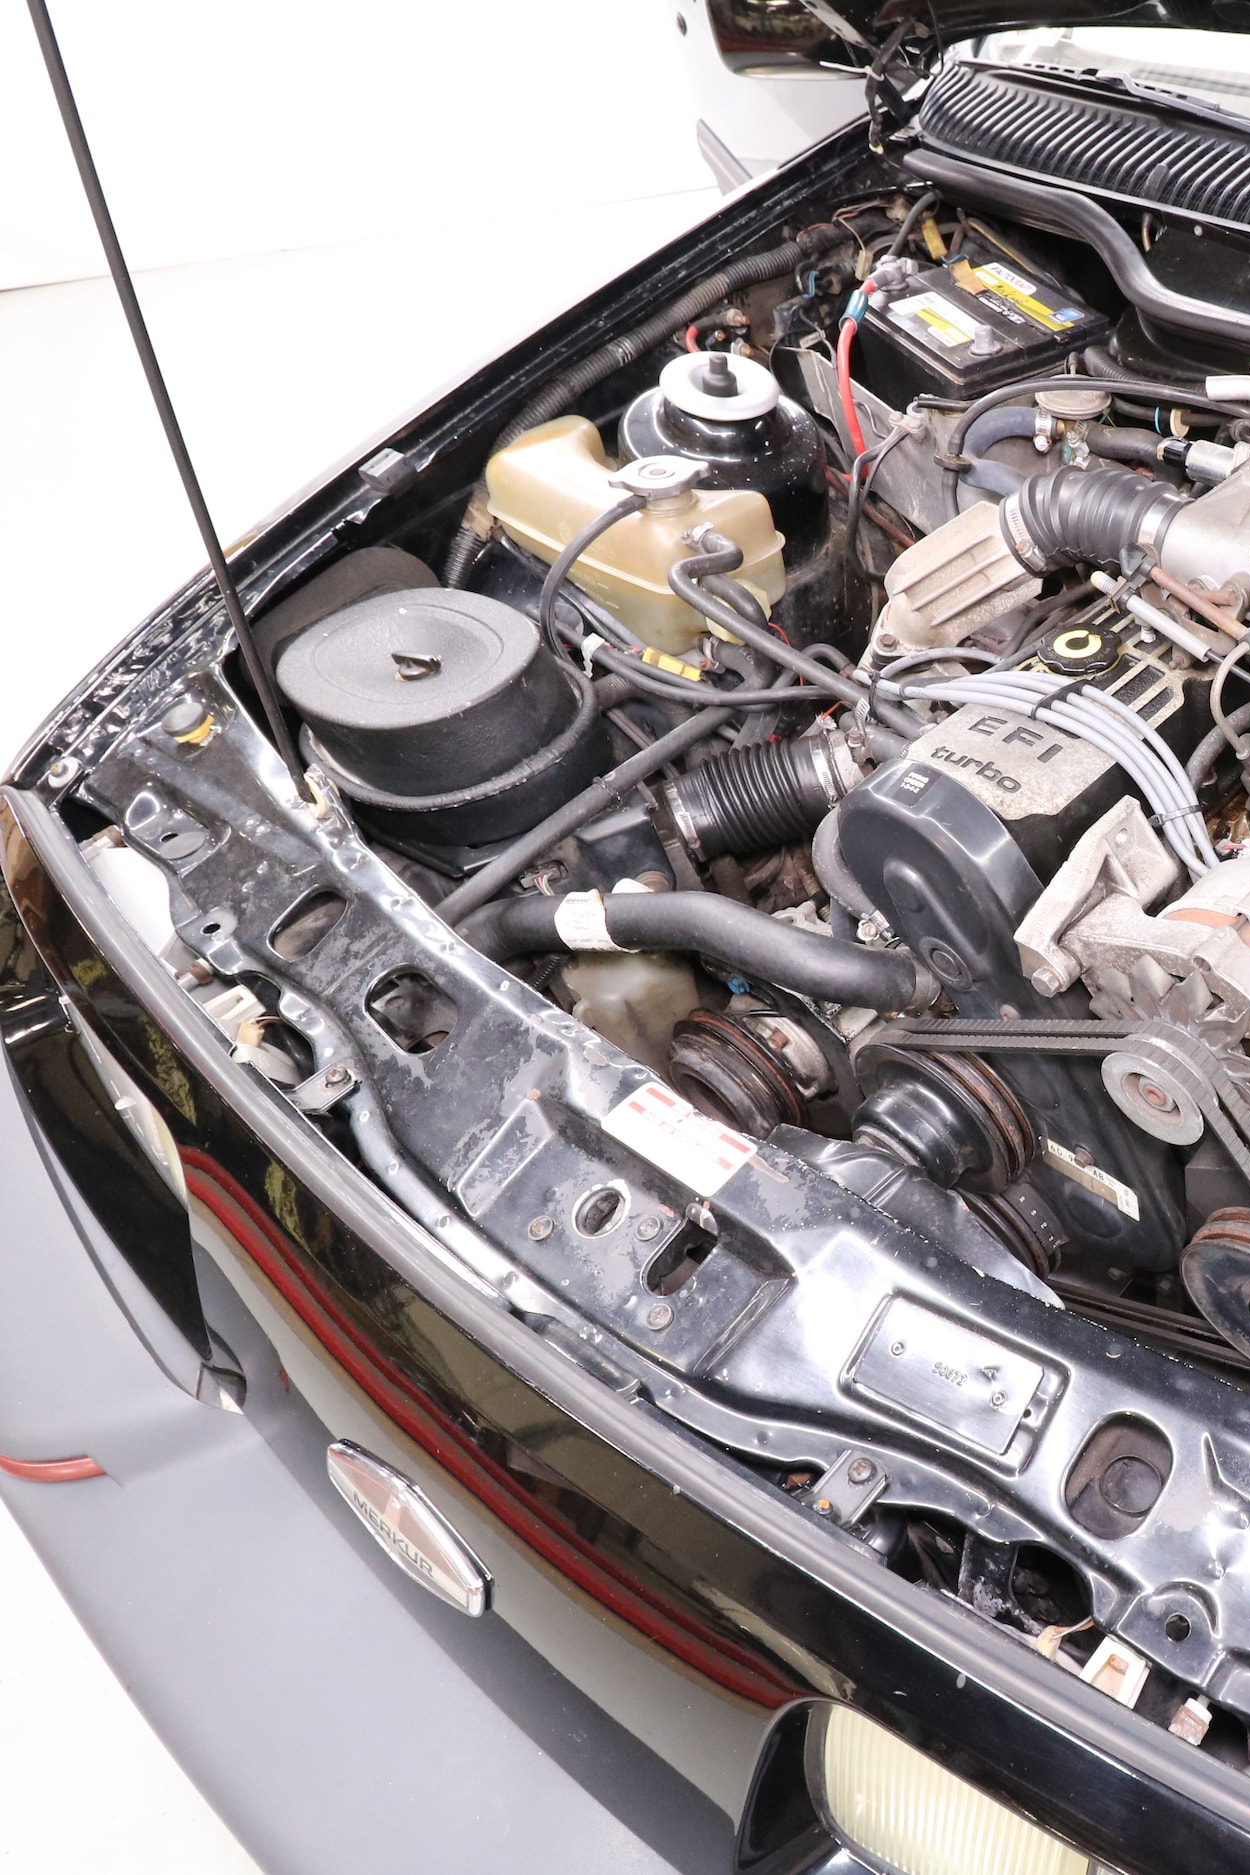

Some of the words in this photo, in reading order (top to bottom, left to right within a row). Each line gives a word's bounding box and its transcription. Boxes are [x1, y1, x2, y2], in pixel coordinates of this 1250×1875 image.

[968, 716, 1064, 763] EFI
[930, 745, 1023, 795] turbo
[353, 1490, 434, 1578] MERKUR
